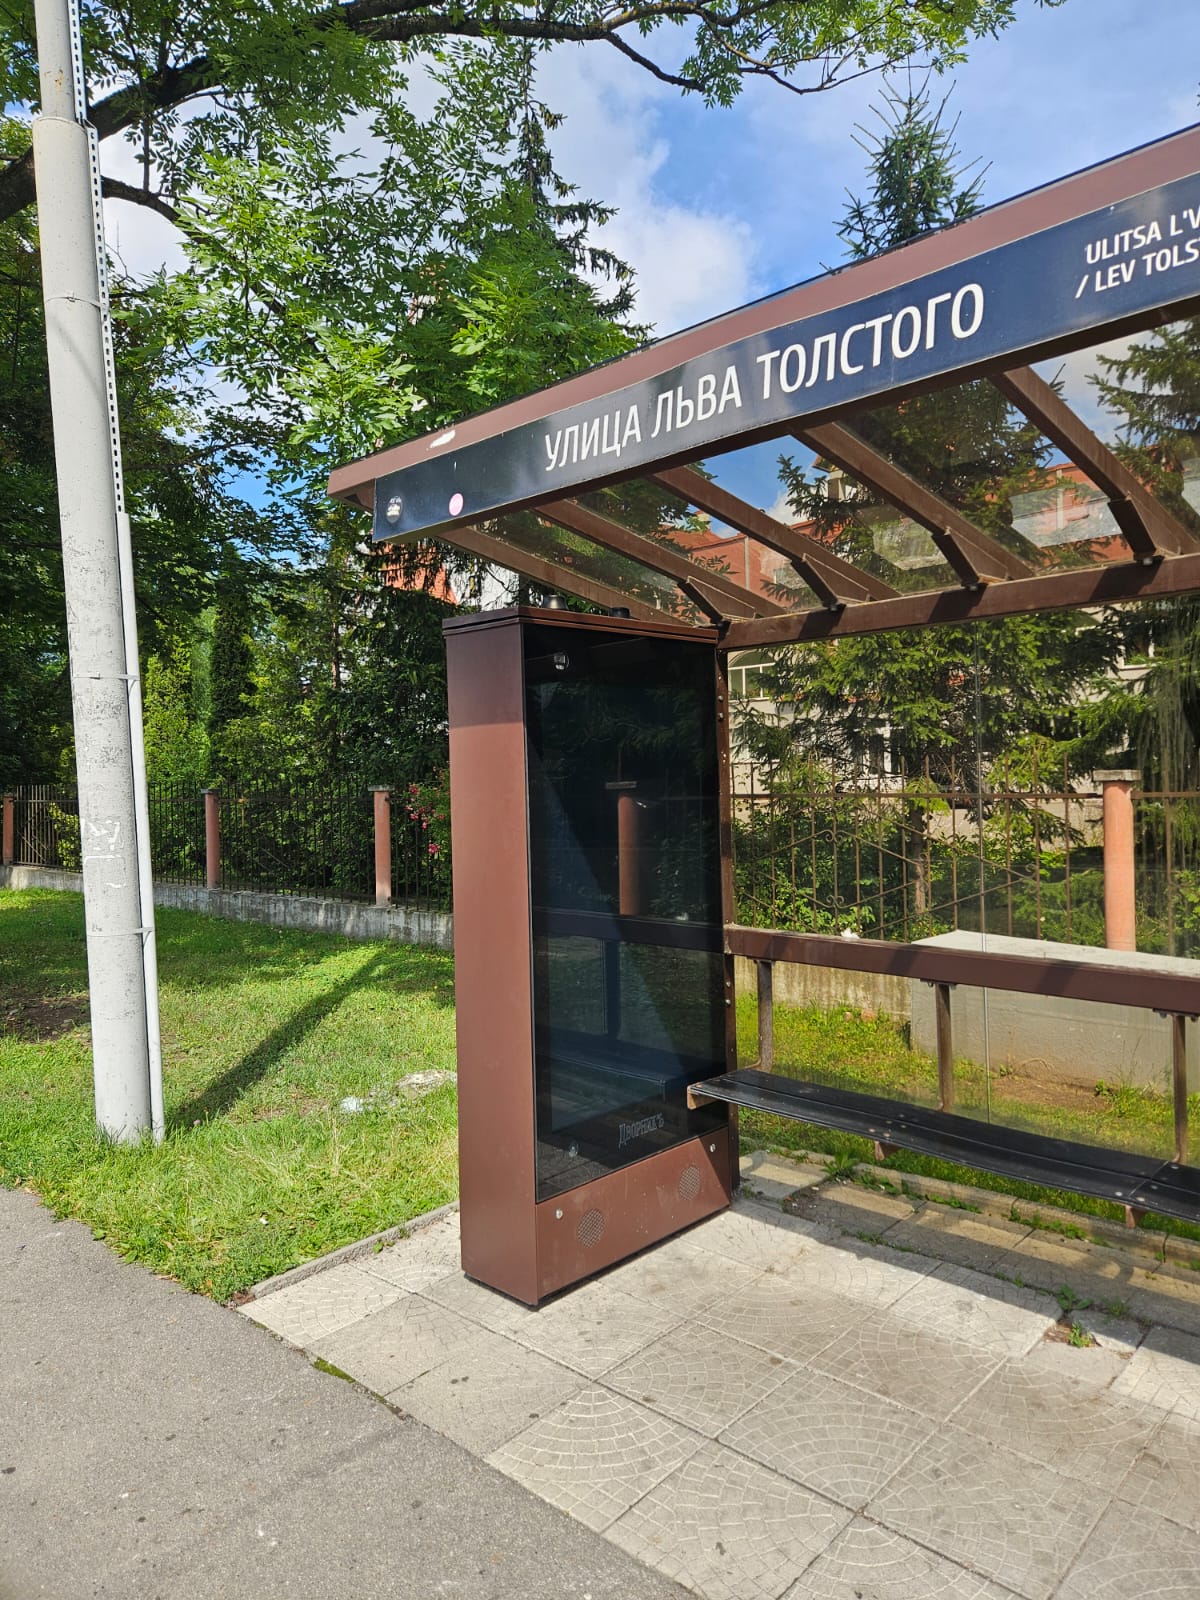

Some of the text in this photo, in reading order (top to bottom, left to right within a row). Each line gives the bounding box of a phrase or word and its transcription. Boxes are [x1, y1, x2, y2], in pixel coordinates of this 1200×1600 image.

[1086, 221, 1162, 264] ULITSA
[1095, 259, 1136, 292] LEV
[1141, 236, 1200, 276] TOLS
[544, 283, 985, 472] УЛИЦА ЛЬВА ТОЛСТОГО
